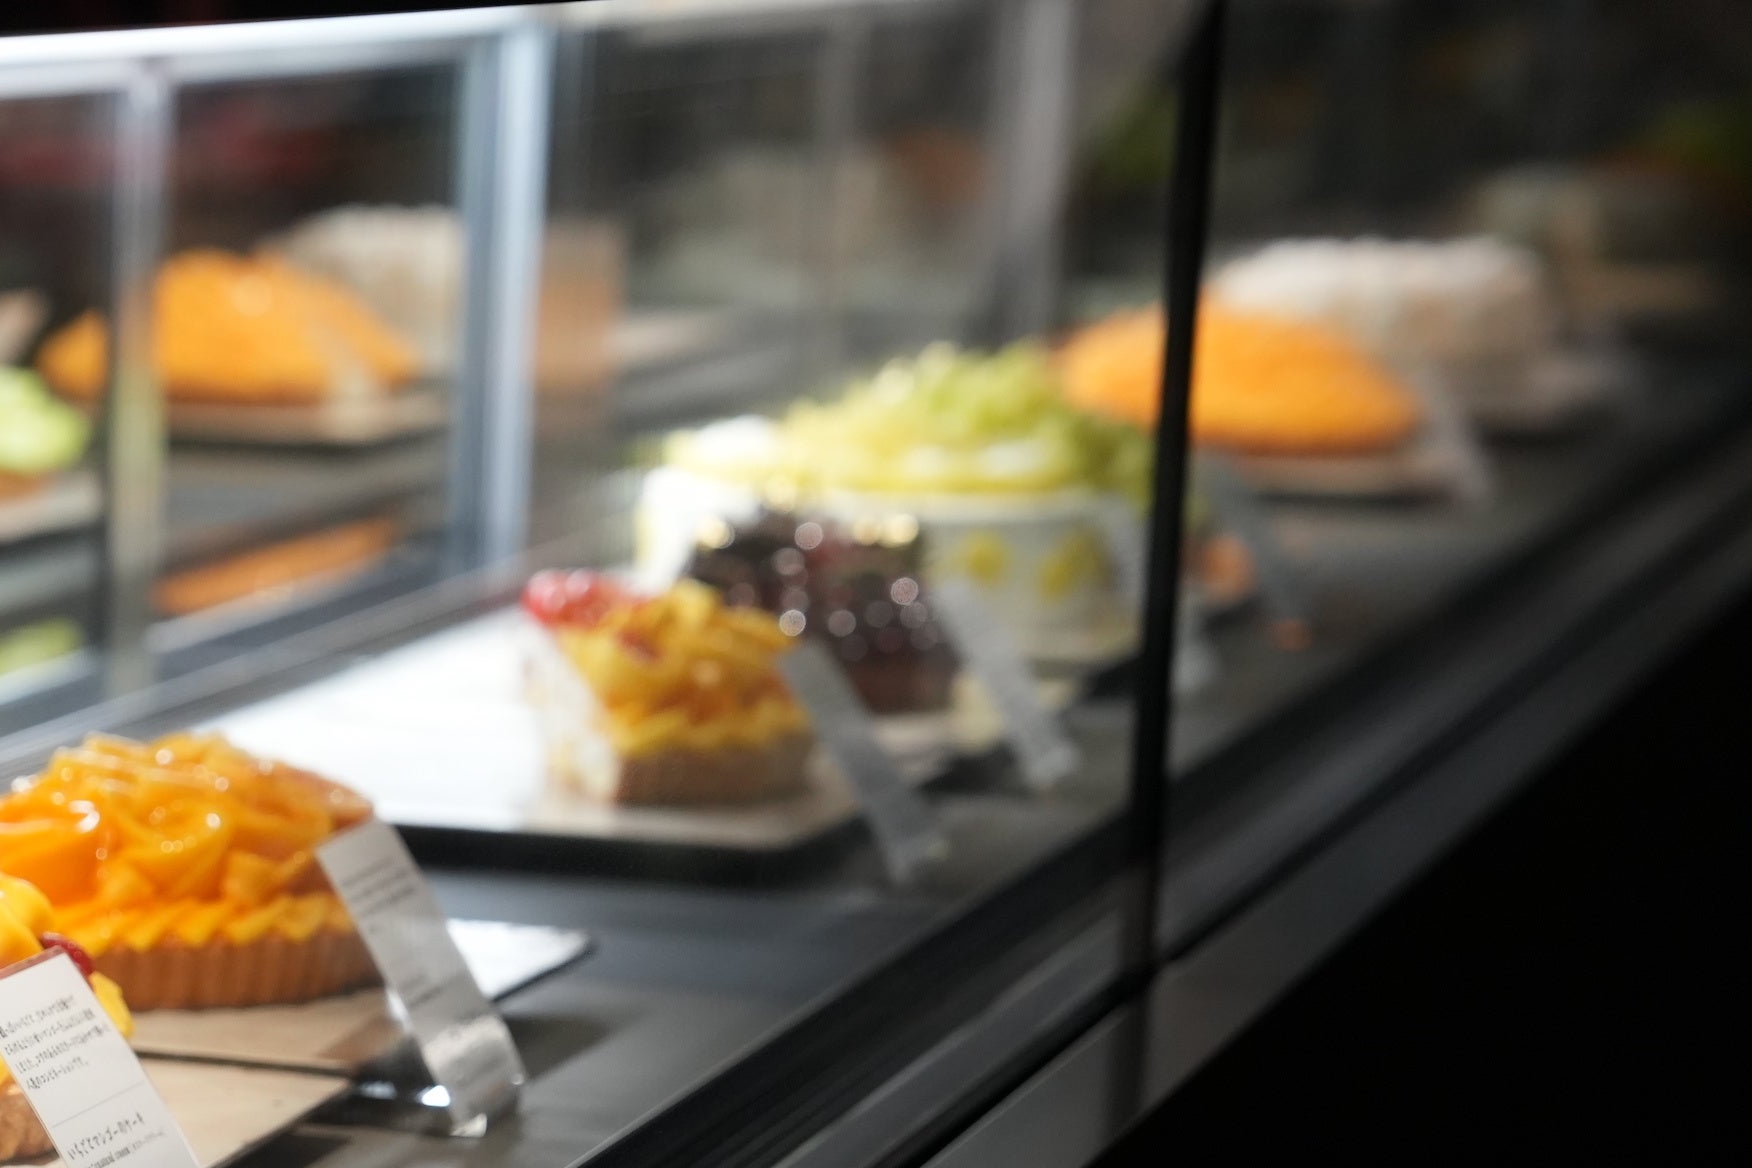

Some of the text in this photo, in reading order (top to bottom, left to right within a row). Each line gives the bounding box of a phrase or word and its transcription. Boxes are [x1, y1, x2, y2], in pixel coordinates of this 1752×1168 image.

[68, 1112, 144, 1160] いちごとマンゴーのケーキ
